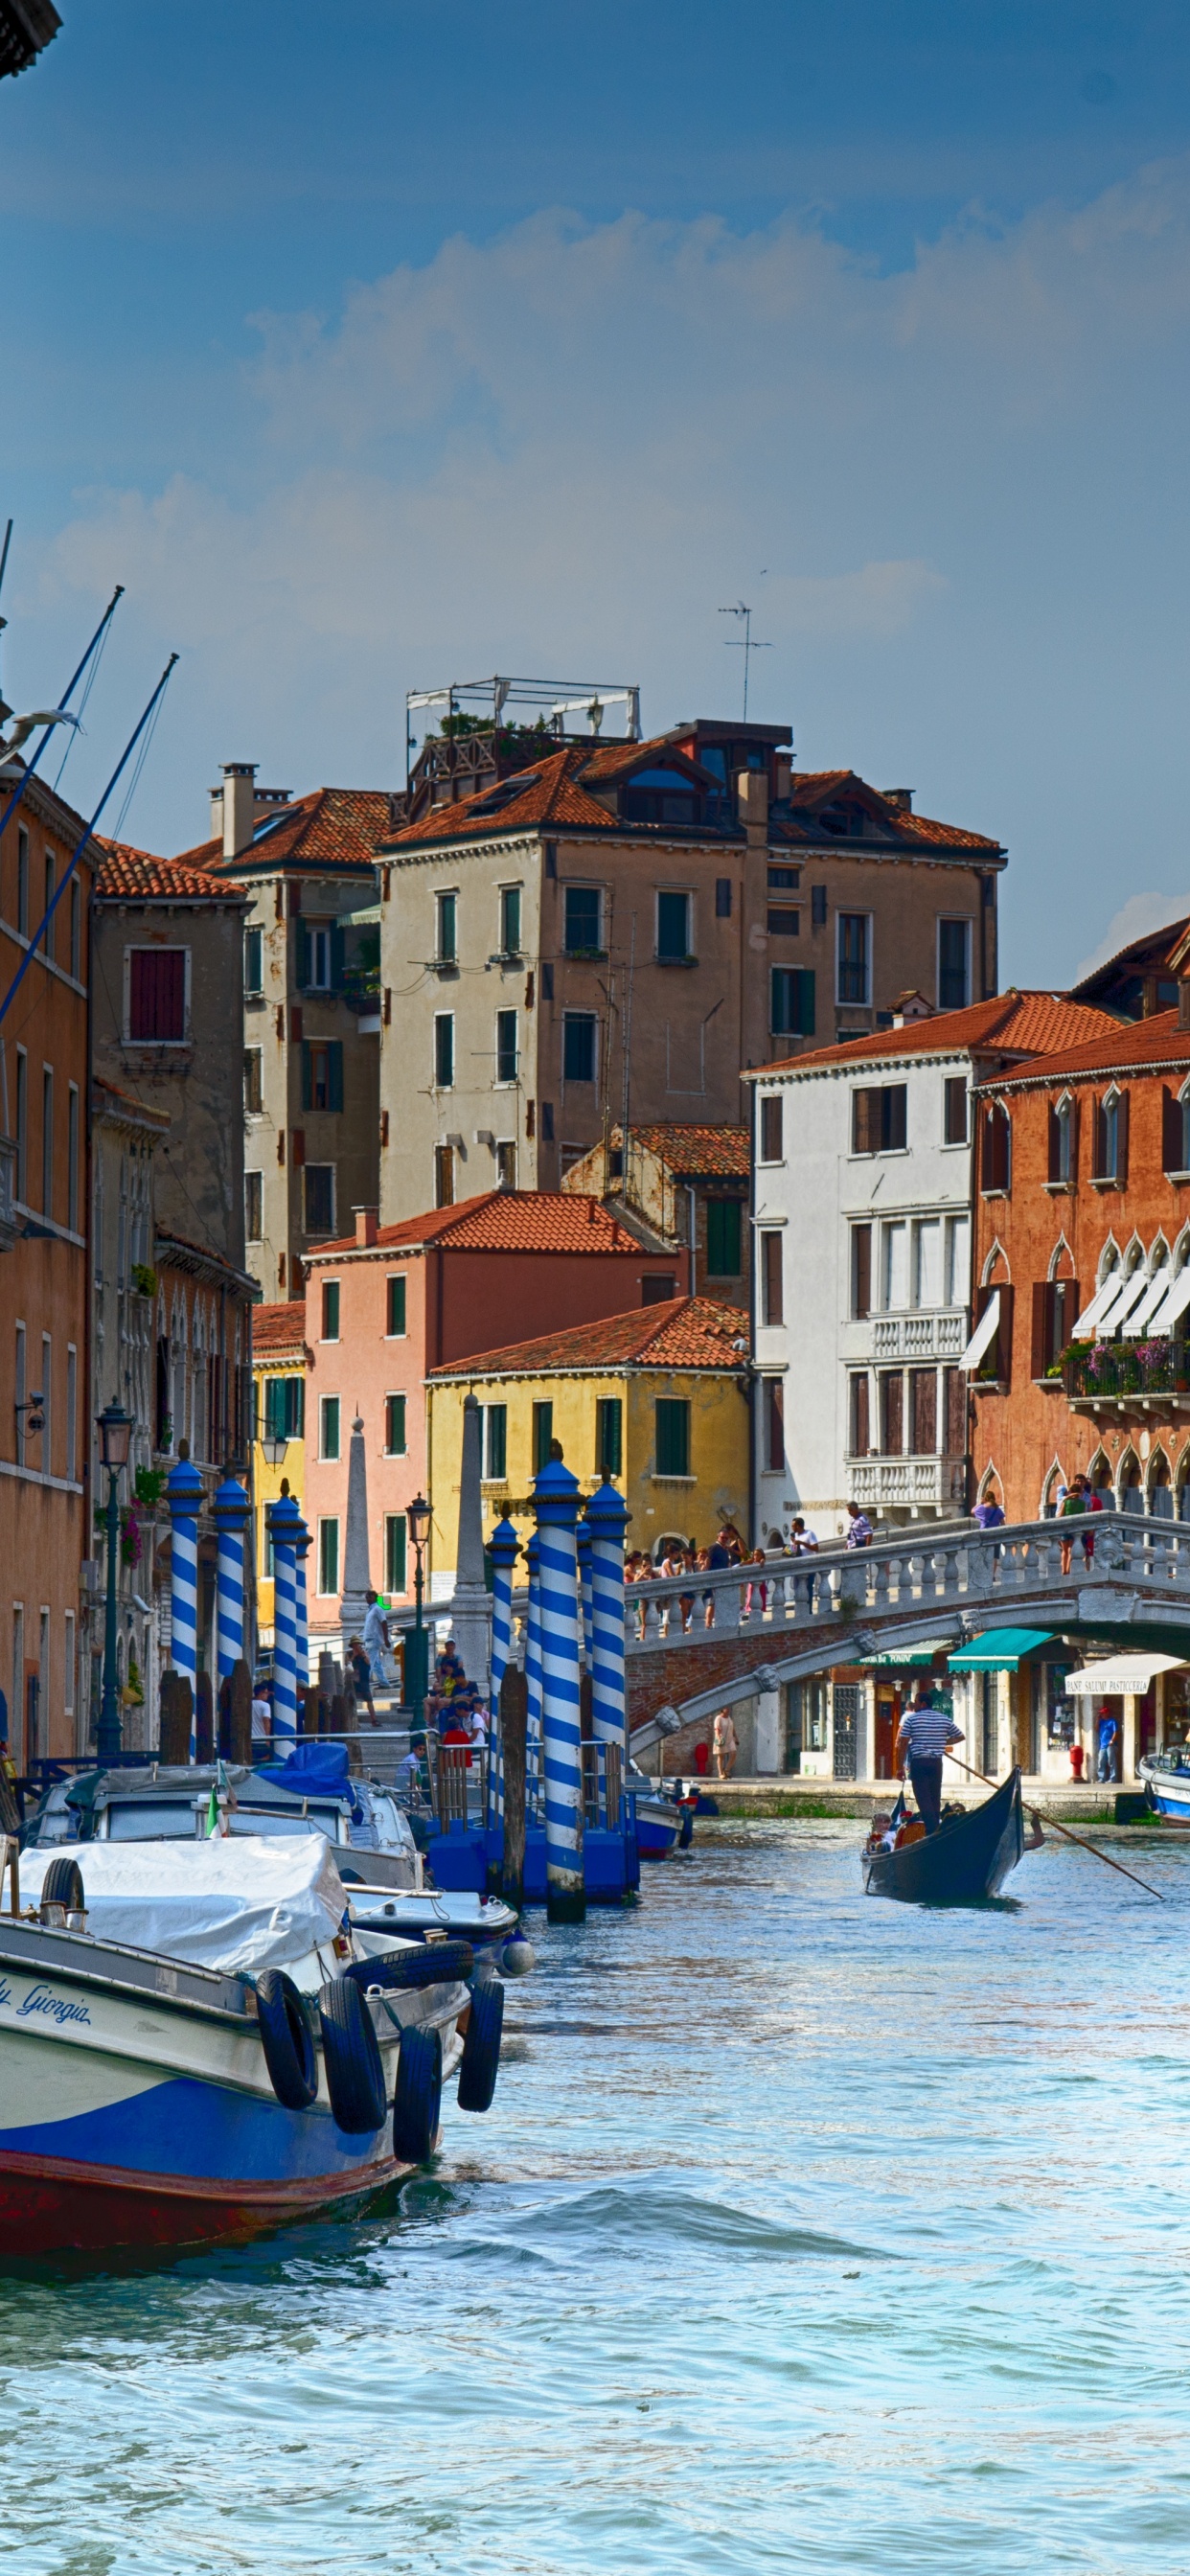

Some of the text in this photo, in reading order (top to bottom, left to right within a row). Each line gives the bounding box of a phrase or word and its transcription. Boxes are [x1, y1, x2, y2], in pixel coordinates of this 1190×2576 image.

[492, 1498, 537, 1517] HTEL
[1066, 1680, 1147, 1692] PANE SALUMI PASTICCERIA
[15, 1984, 92, 2026] Giorgia
